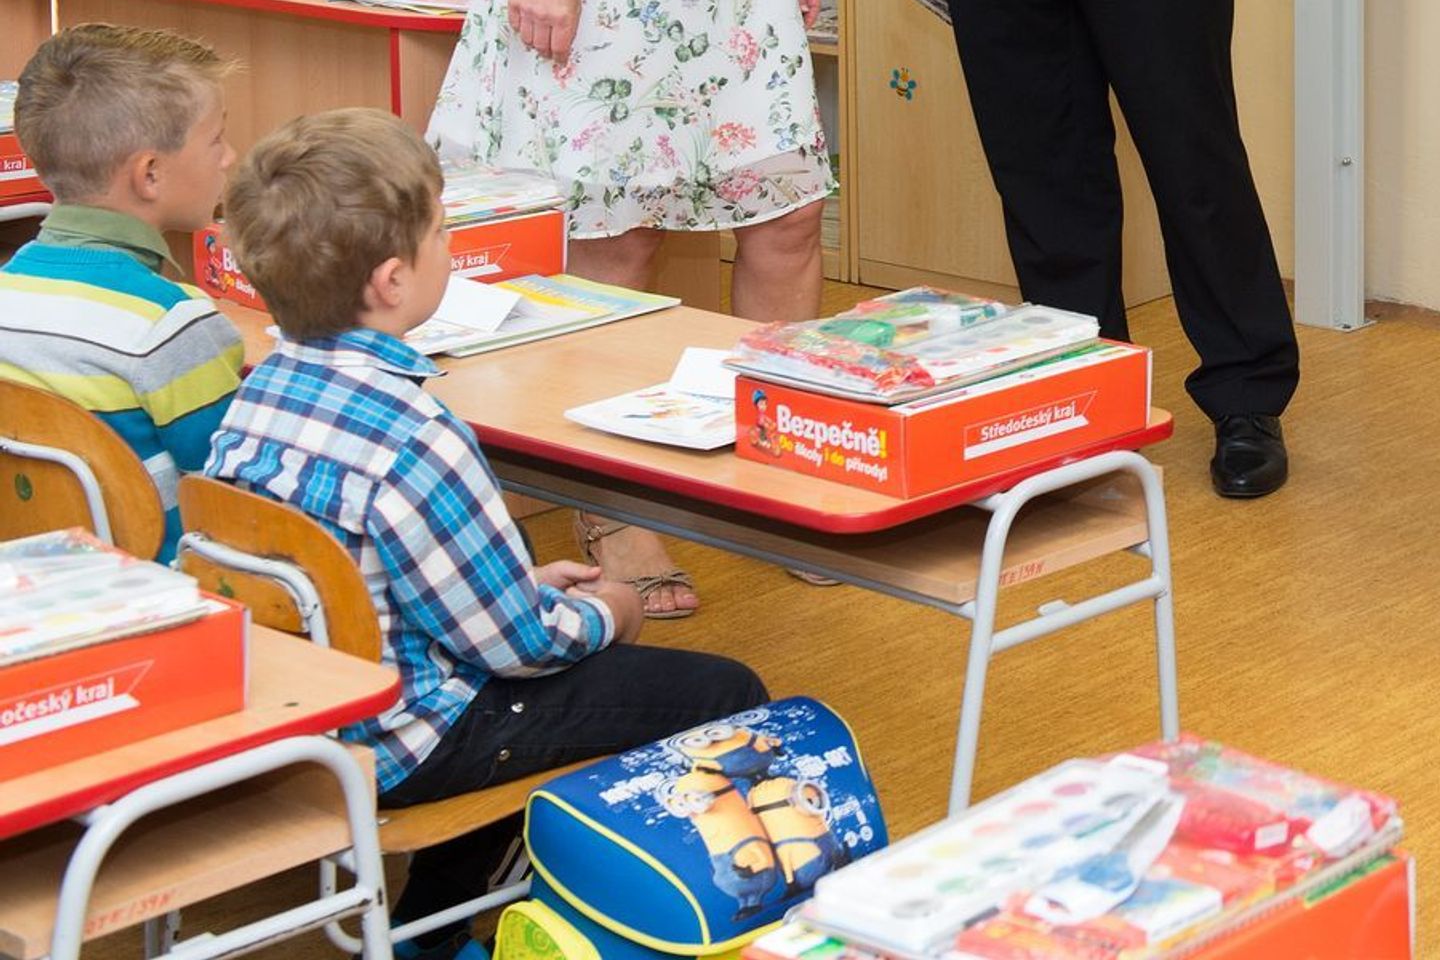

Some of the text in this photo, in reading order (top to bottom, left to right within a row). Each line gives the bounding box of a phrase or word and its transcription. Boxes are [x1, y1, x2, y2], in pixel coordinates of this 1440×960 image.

[3, 156, 28, 171] kraj
[466, 251, 489, 267] kraj
[776, 403, 888, 460] Bezpečně!
[980, 399, 1077, 442] Středočeský kraj
[0, 676, 115, 728] očeský kraj
